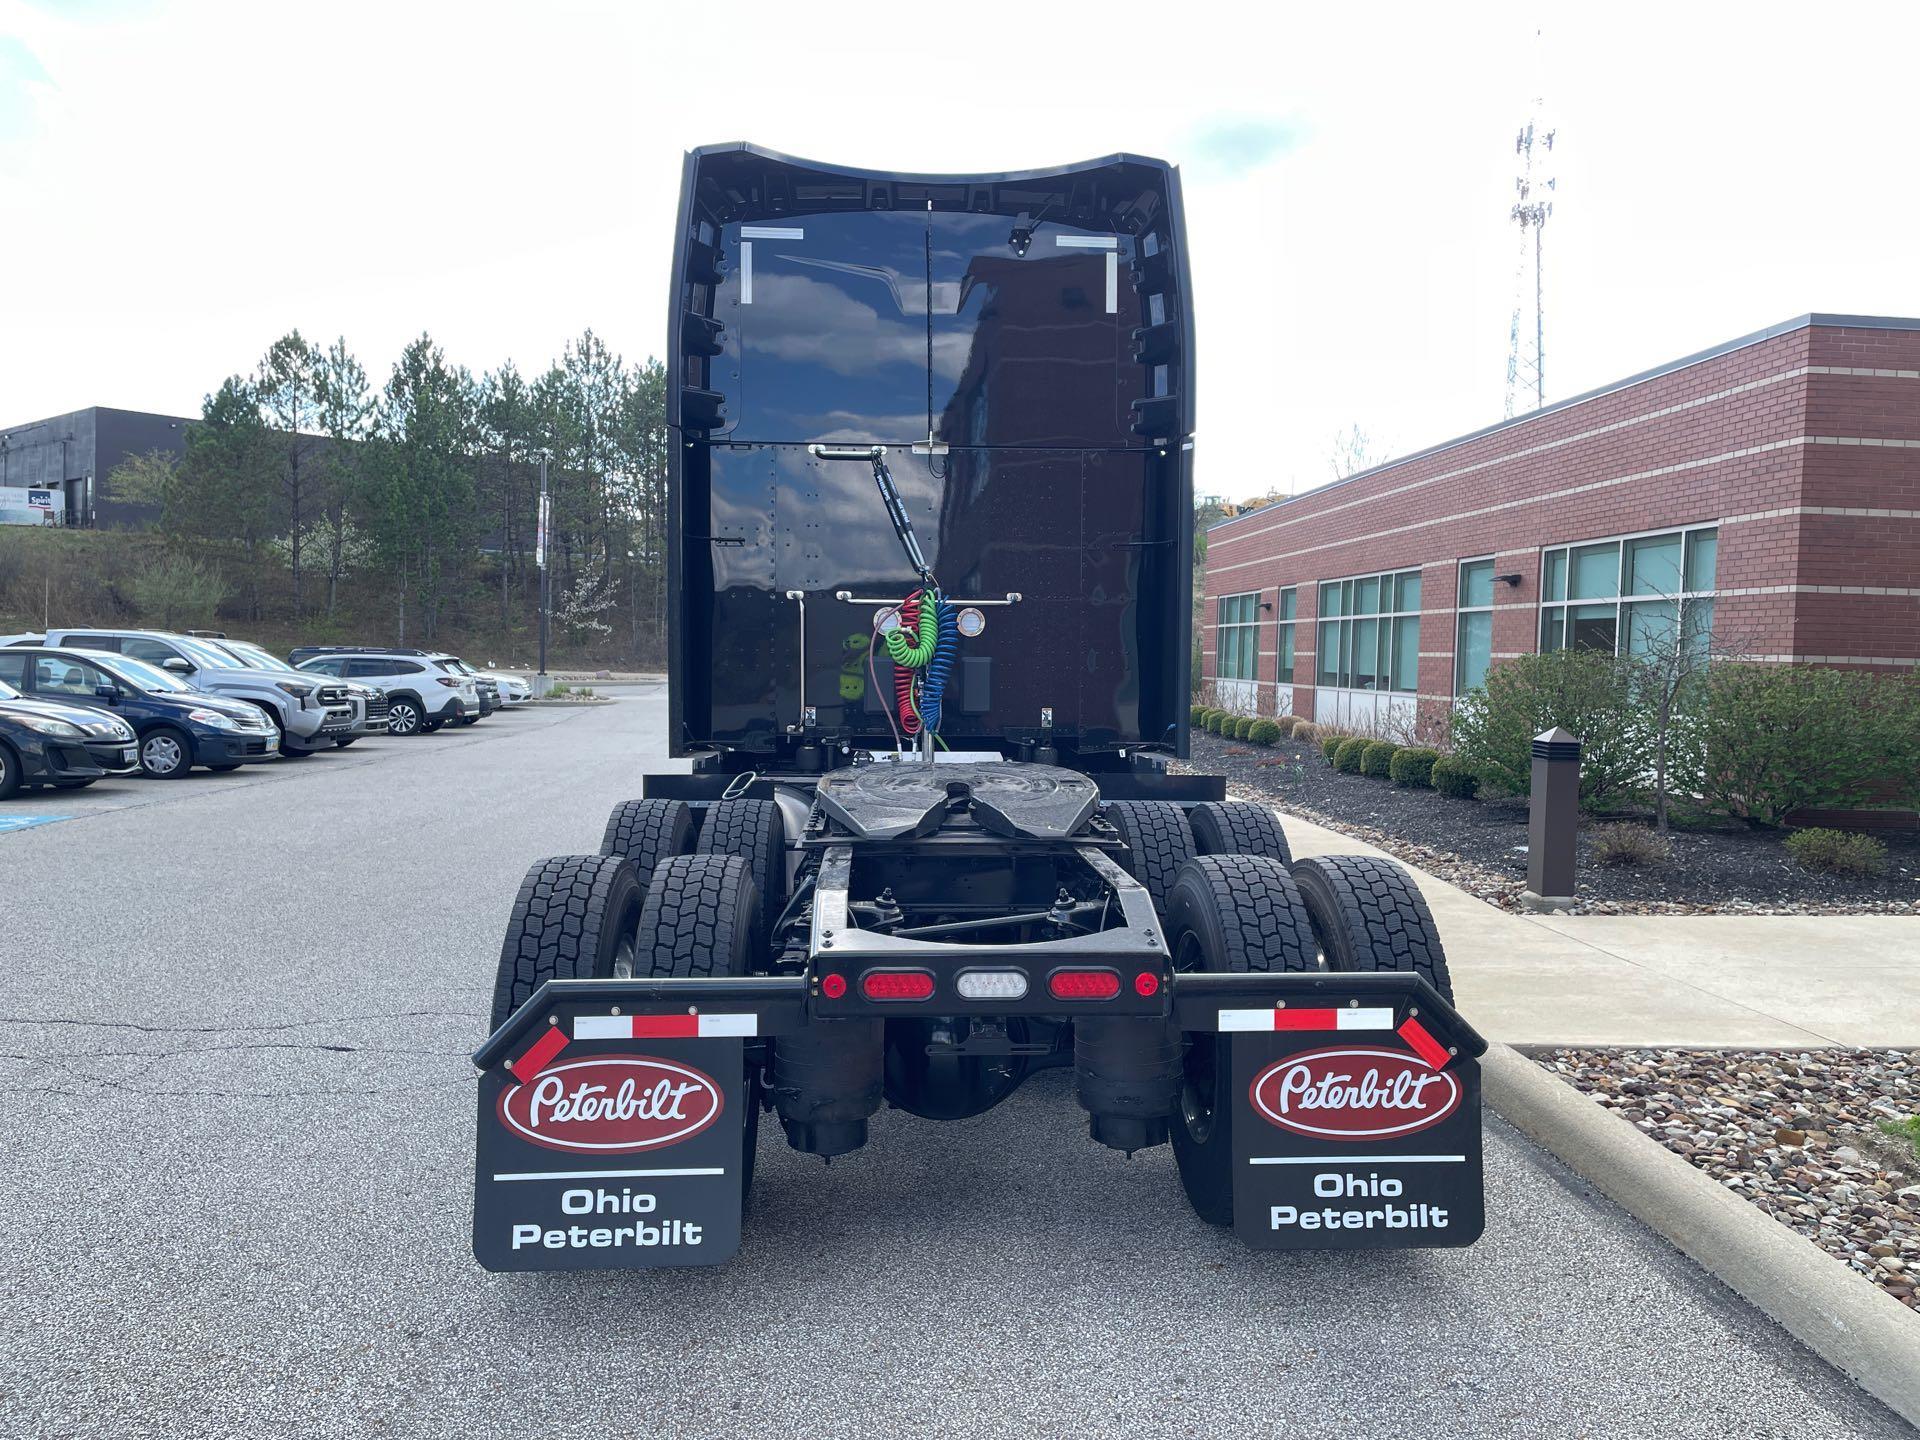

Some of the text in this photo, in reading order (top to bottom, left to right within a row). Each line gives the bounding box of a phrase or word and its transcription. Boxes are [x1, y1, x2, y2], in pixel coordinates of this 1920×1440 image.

[530, 1076, 702, 1127] Peterbilt
[1280, 1065, 1441, 1114] Peterbilt
[1314, 1173, 1402, 1197] Ohio
[561, 1188, 656, 1215] Ohio
[1270, 1203, 1448, 1230] Peterbilt
[512, 1220, 702, 1250] Peterbilt
